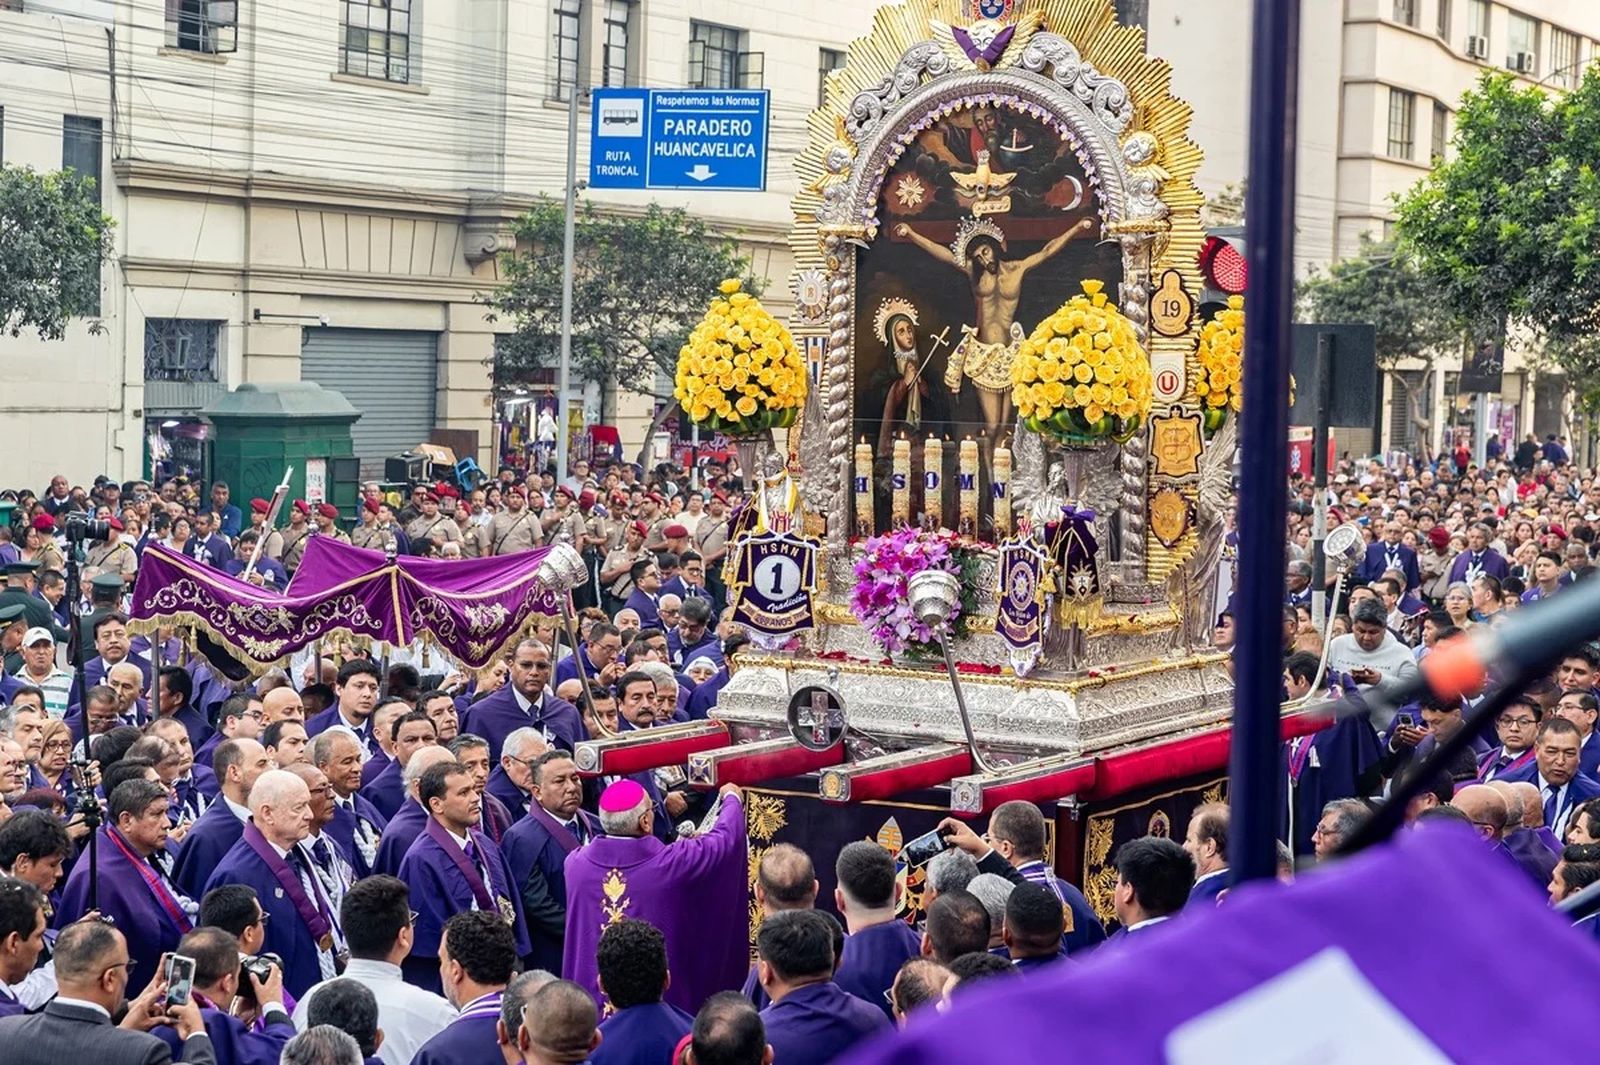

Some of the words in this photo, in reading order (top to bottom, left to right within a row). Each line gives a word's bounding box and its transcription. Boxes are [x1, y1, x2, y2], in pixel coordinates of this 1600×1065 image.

[656, 95, 709, 107] Respetemos
[711, 96, 724, 106] las
[725, 96, 760, 106] Normas
[663, 119, 752, 136] PARADERO
[605, 151, 631, 161] RUTA
[654, 142, 756, 158] HUANCAVELICA
[596, 165, 639, 176] TRONCAL
[1161, 299, 1181, 318] 19
[1162, 375, 1174, 391] U
[892, 474, 906, 490] S
[959, 474, 975, 490] M
[770, 562, 783, 595] 1
